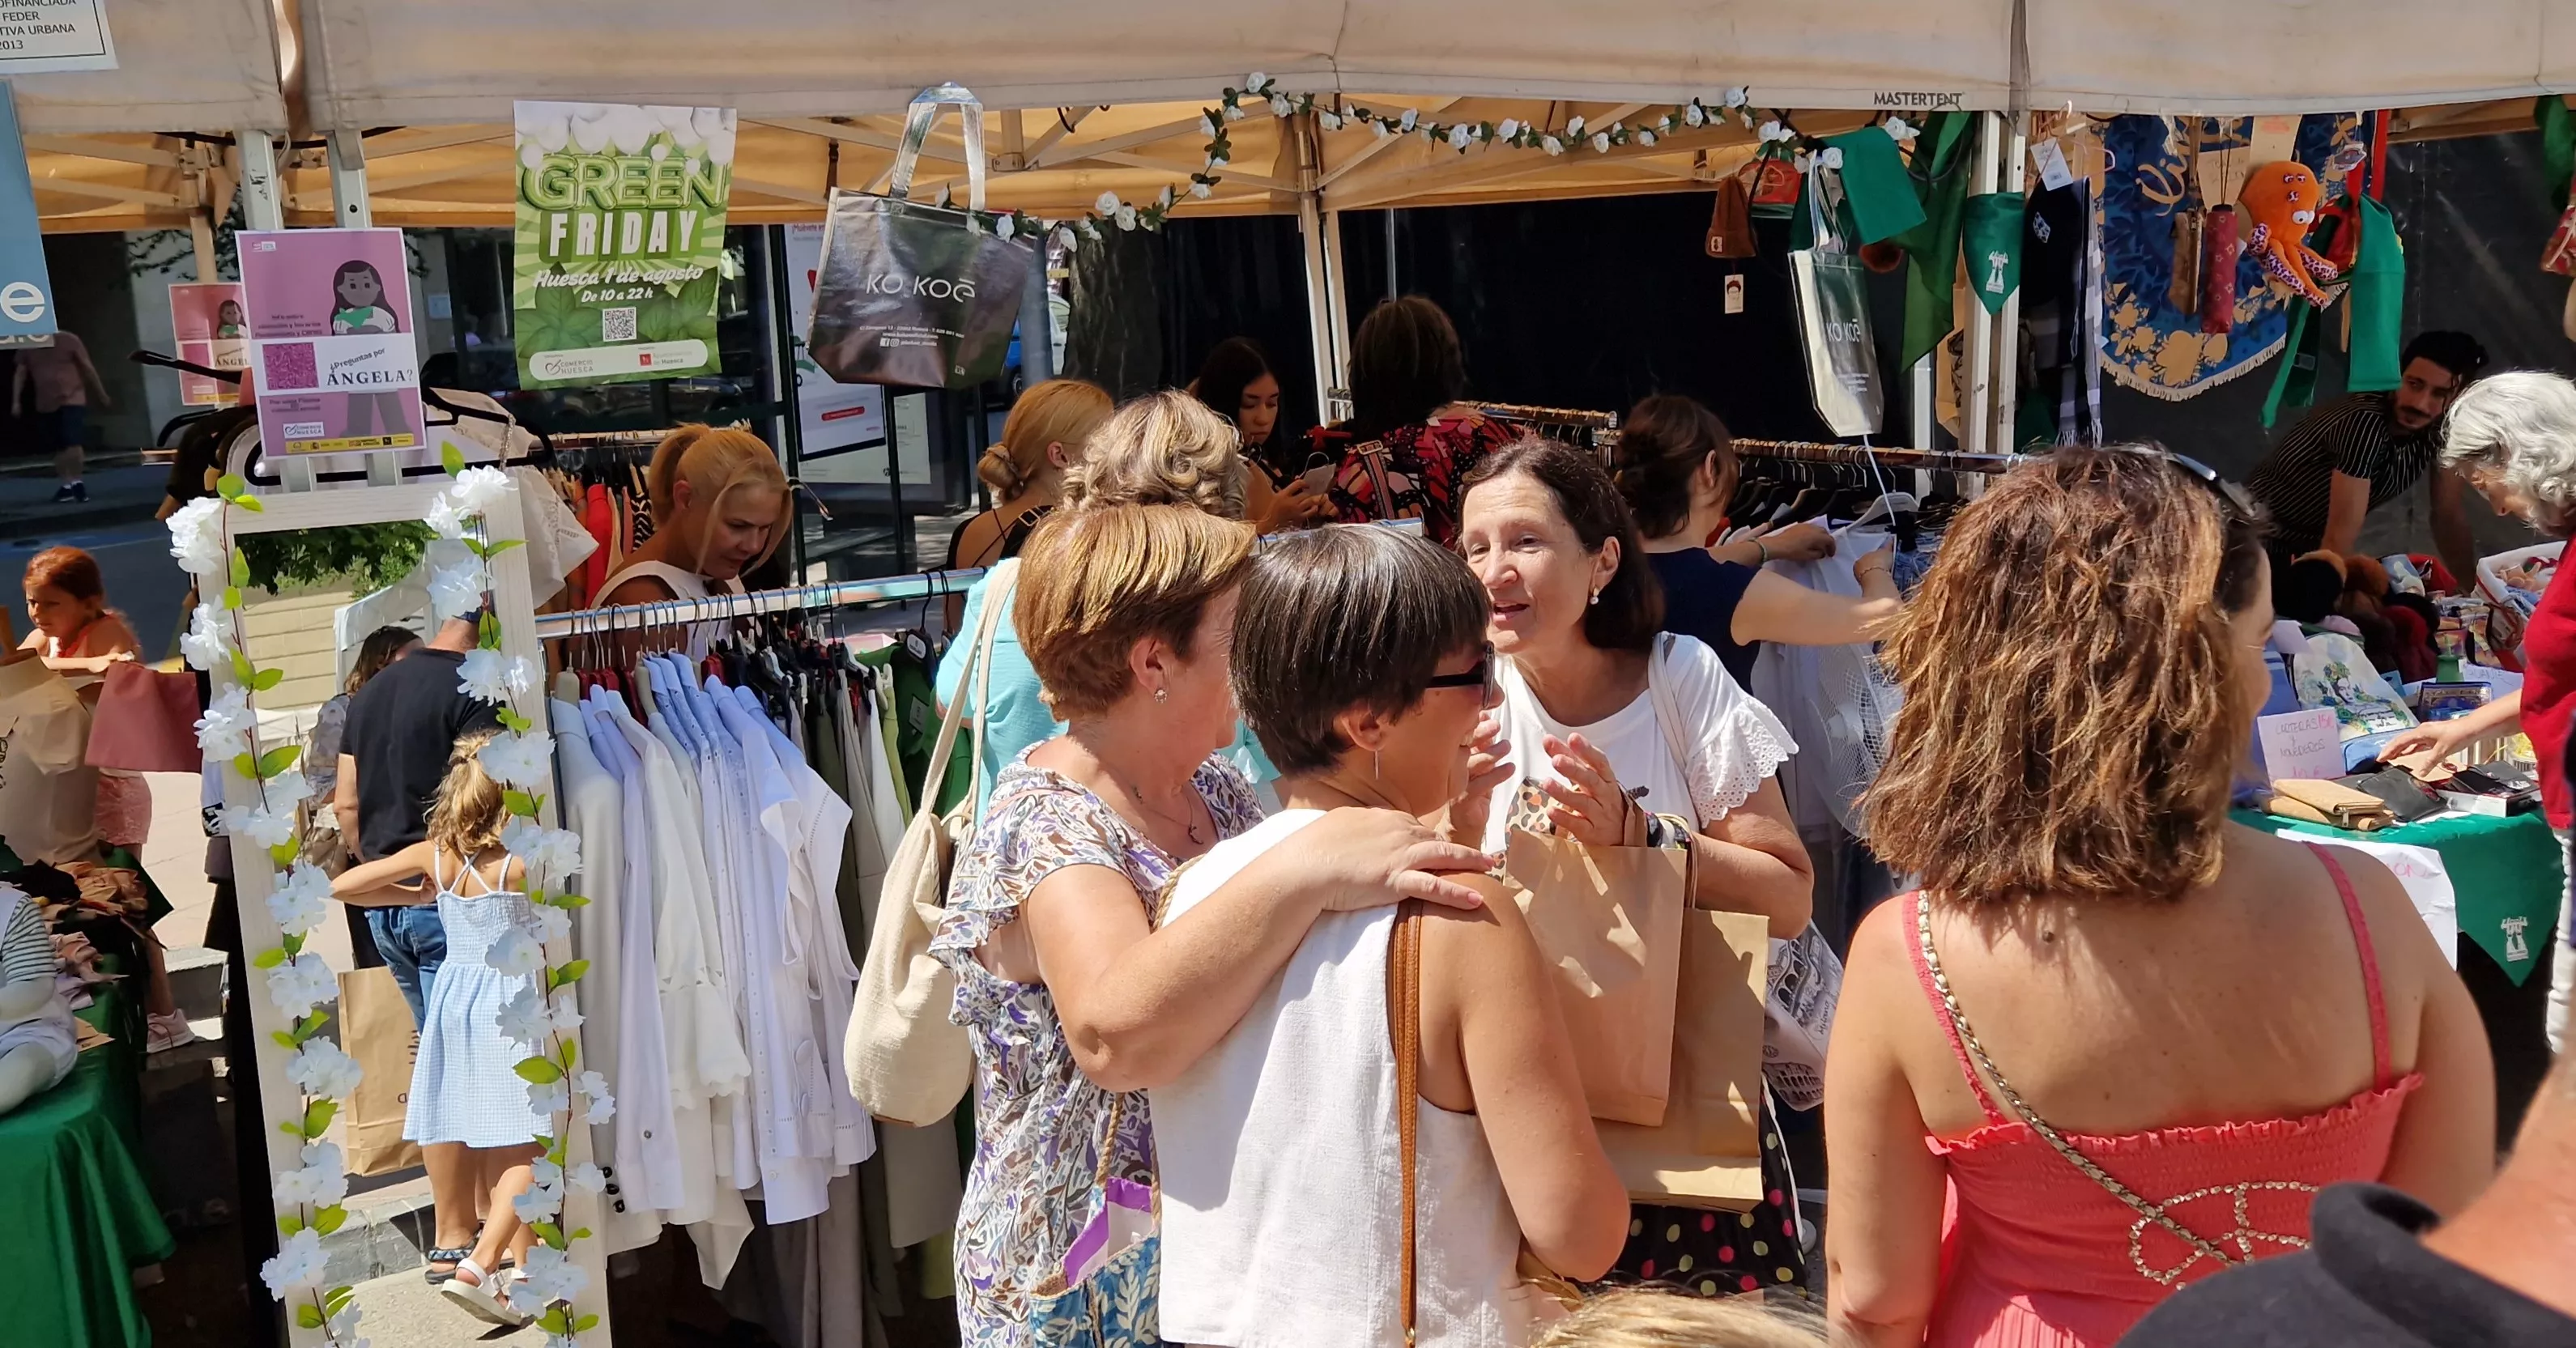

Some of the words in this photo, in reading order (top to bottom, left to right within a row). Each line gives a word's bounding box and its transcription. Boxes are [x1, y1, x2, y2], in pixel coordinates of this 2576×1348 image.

[2, 11, 40, 21] FEDER
[28, 23, 76, 35] URBANA
[0, 40, 23, 49] 013
[1874, 91, 1962, 105] MASTERTENT
[522, 153, 729, 210] GREEN
[549, 210, 697, 257] FRIDAY
[534, 270, 600, 287] Huesca
[605, 267, 616, 284] 1
[615, 266, 640, 284] de
[642, 265, 705, 285] agosto
[866, 274, 904, 294] KO
[581, 291, 598, 303] De
[600, 288, 615, 300] 10
[616, 292, 624, 300] a
[626, 287, 642, 300] 22
[643, 287, 654, 299] h
[1826, 321, 1842, 342] KO
[330, 352, 373, 370] ¿Preguntas
[373, 348, 385, 358] por
[560, 359, 593, 368] COMERCIO
[561, 366, 594, 374] HUESCA
